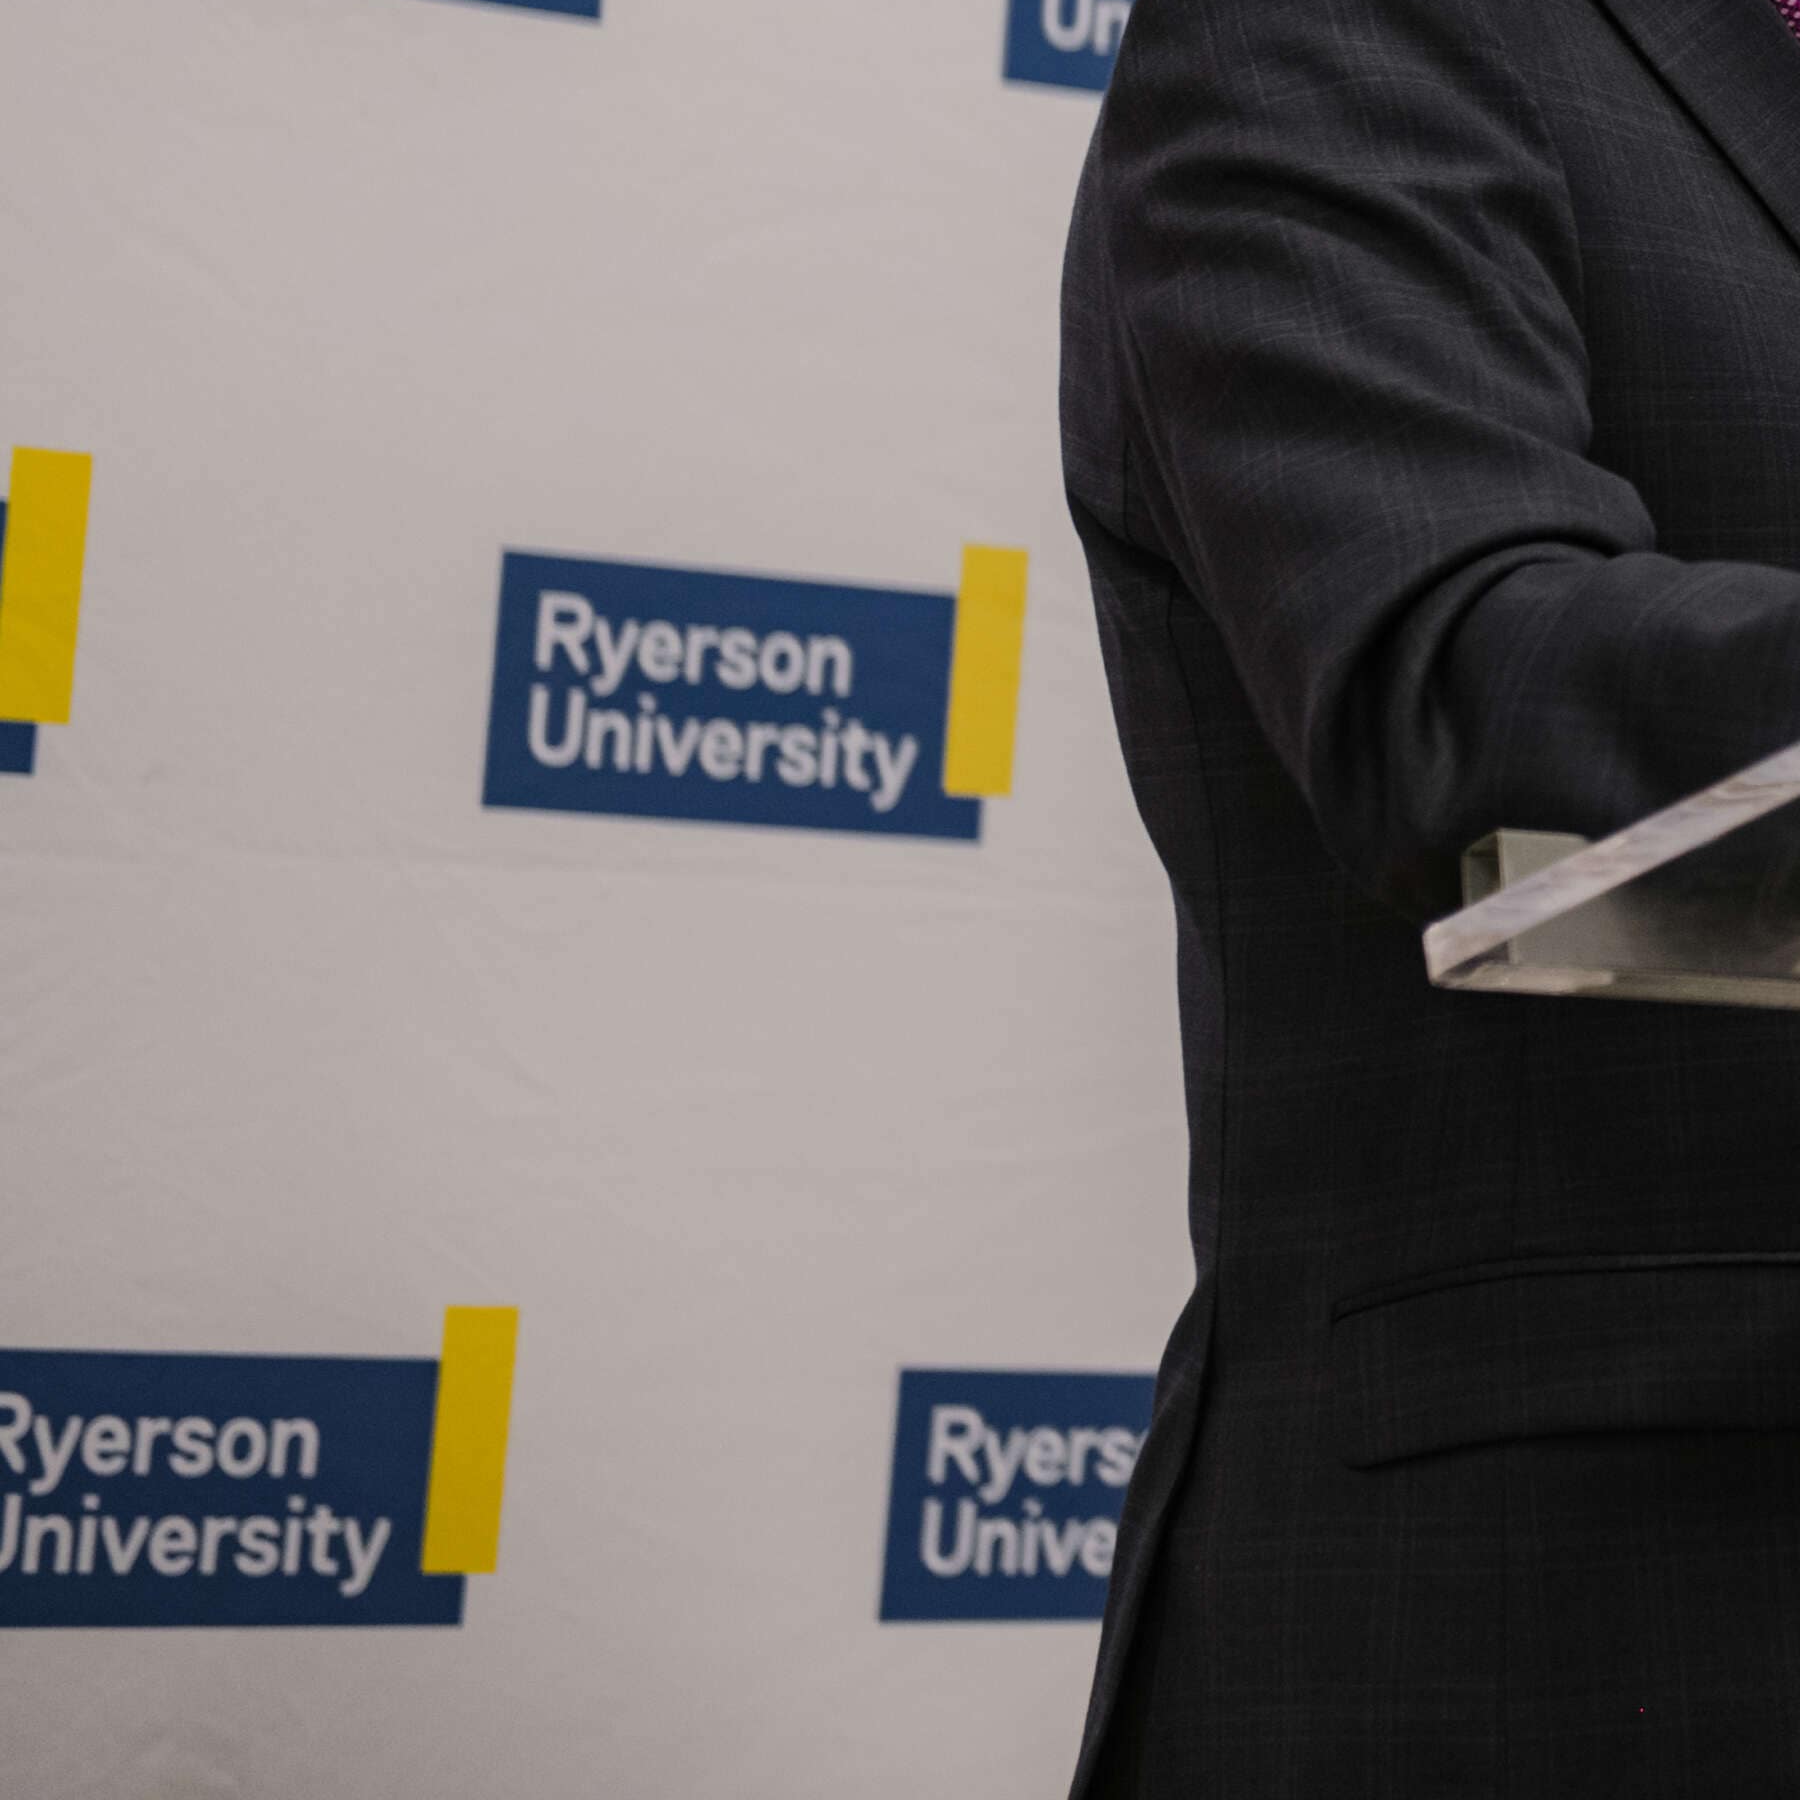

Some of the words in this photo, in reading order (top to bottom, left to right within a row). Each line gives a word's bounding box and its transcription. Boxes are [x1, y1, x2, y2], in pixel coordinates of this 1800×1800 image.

[533, 588, 854, 699] Ryerson
[527, 682, 919, 814] University
[927, 1403, 1150, 1508] Ryers
[918, 1495, 1120, 1579] Unive
